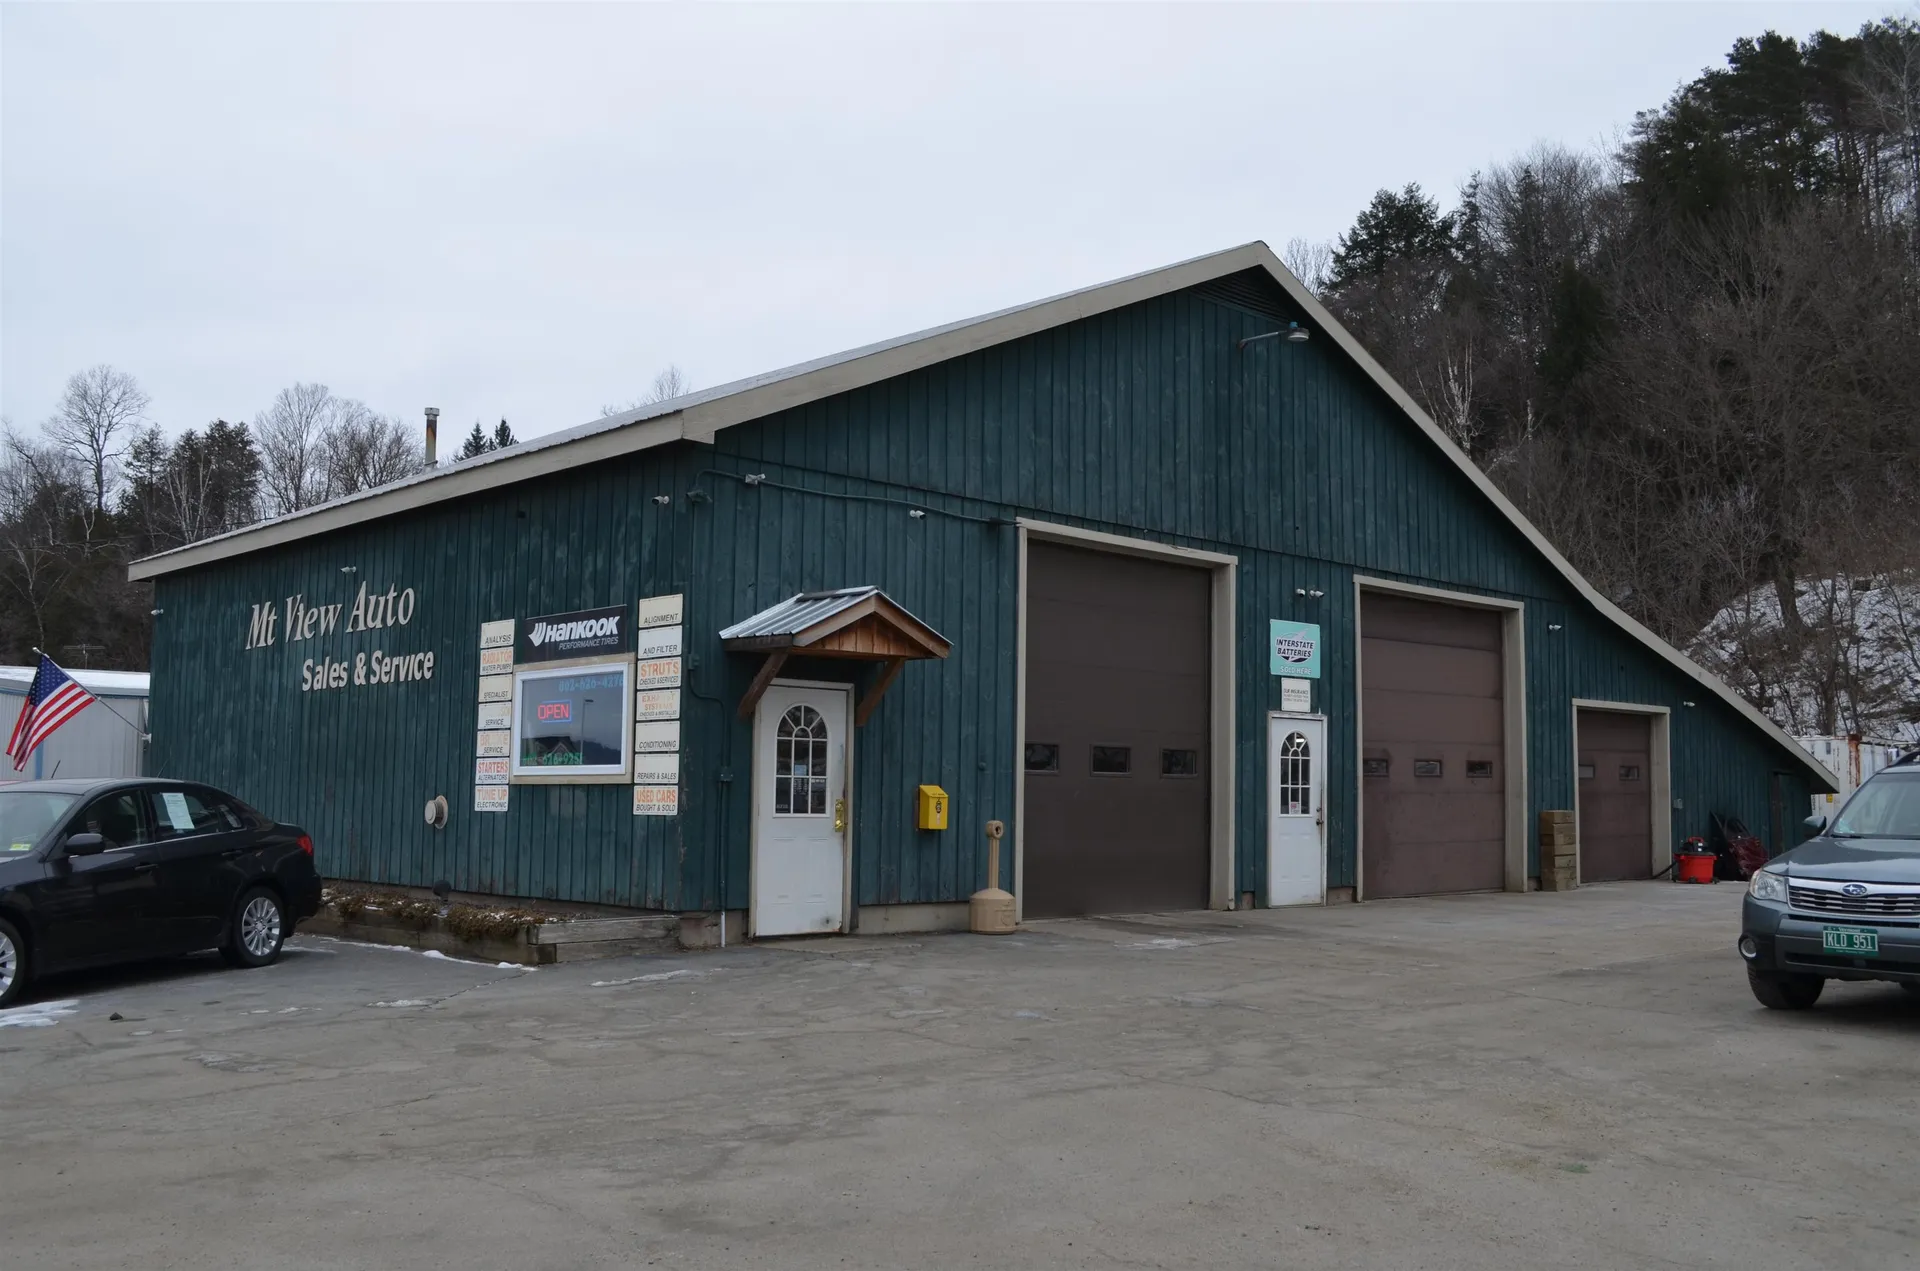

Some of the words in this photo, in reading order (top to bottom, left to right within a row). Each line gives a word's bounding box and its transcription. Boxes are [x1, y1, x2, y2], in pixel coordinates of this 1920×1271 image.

[246, 601, 277, 650] Mt
[285, 594, 342, 643] View
[345, 580, 415, 633] Auto
[644, 613, 678, 624] ALIGNMENT
[485, 634, 511, 644] ANALYSIS
[558, 638, 600, 650] PERFORMANCE
[601, 636, 619, 645] TIRES
[1276, 639, 1314, 649] INTERSTATE
[643, 646, 655, 655] AND
[656, 644, 678, 653] FILTER
[1277, 647, 1312, 657] BATTERIES
[302, 657, 348, 691] Sales
[354, 652, 367, 686] &
[370, 650, 434, 685] Service
[482, 664, 496, 672] WATER
[497, 663, 511, 671] PUMPS
[641, 661, 679, 677] STRUTS
[1297, 667, 1312, 675] HERE
[484, 691, 508, 699] SPECIALIST
[537, 704, 570, 720] OPEN
[485, 718, 504, 726] SERVICE
[639, 740, 676, 749] CONDITIONING
[484, 746, 503, 754] SERVICE
[478, 760, 508, 773] STARTERS
[478, 773, 507, 781] ALTERNATORS
[660, 772, 676, 780] SALES
[477, 789, 496, 800] TUNE
[498, 788, 507, 800] UP
[636, 790, 655, 803] USED
[656, 789, 676, 803] CARS
[477, 801, 507, 809] ELECTRONIC
[636, 804, 656, 812] BOUGHT
[661, 804, 676, 812] SOLD
[1853, 935, 1873, 949] 951
